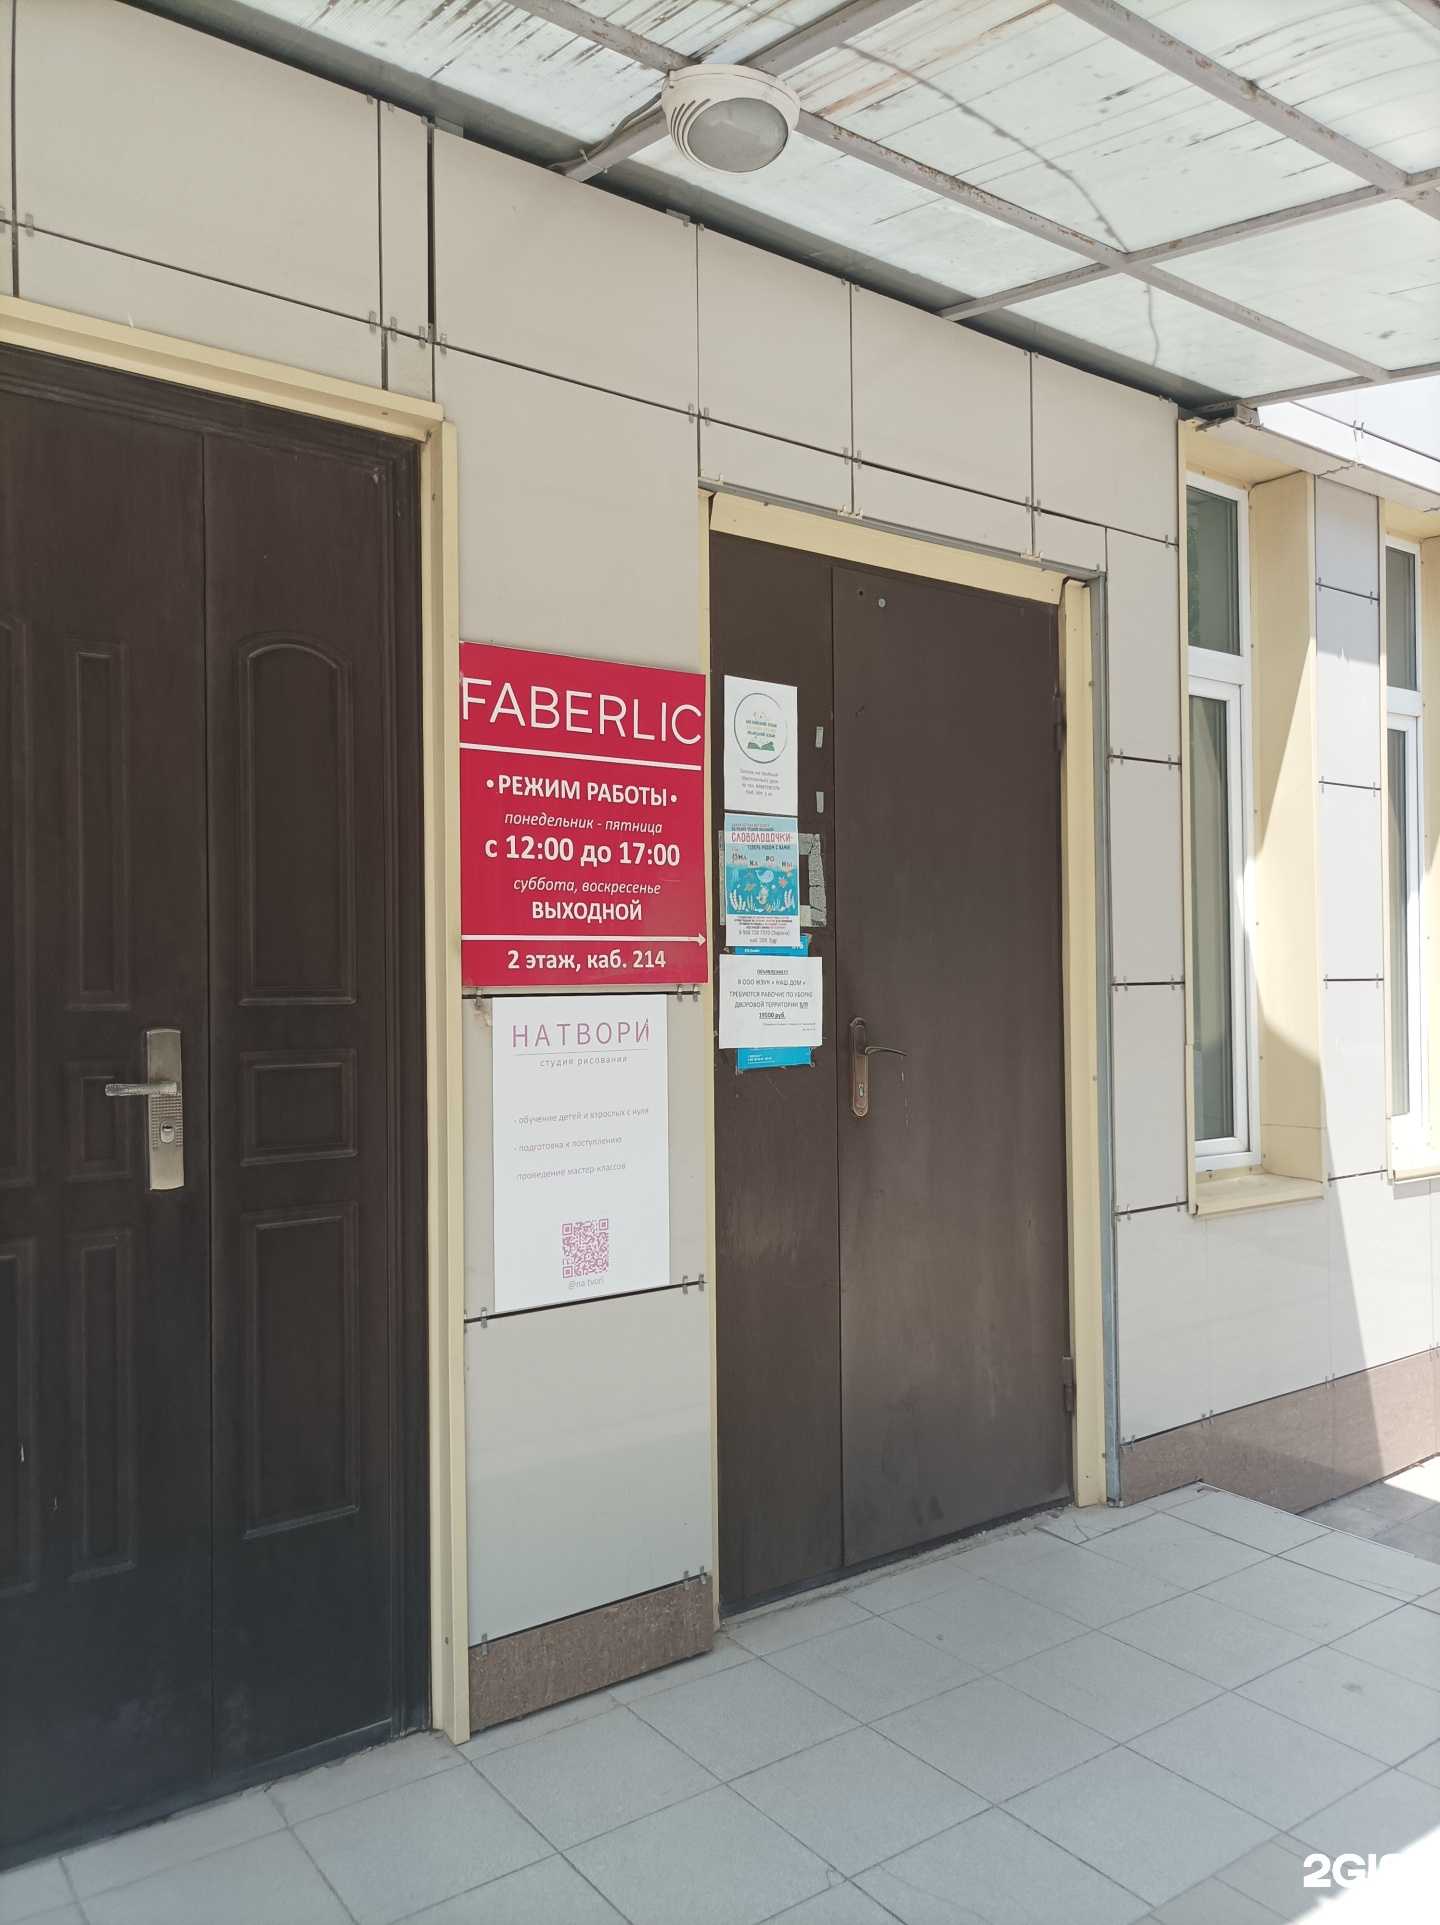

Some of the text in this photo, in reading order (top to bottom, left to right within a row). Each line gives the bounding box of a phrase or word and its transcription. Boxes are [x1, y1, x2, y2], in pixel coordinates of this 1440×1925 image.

[462, 676, 703, 746] FABERLIC
[498, 773, 667, 807] РЕЖИМ РАБОТЫ
[504, 812, 594, 830] понедельник
[605, 820, 663, 836] пятница
[505, 835, 575, 862] 12:00
[580, 844, 612, 868] до
[619, 841, 682, 867] 17:00
[513, 876, 662, 895] суббота, воскресенье
[532, 899, 643, 924] ВЫХОДНОЙ
[507, 949, 667, 973] 2 этаж, каб. 214
[540, 1055, 629, 1069] студия рисования
[559, 1110, 582, 1121] детей
[519, 1141, 564, 1153] подготовка
[571, 1136, 623, 1149] поступлению
